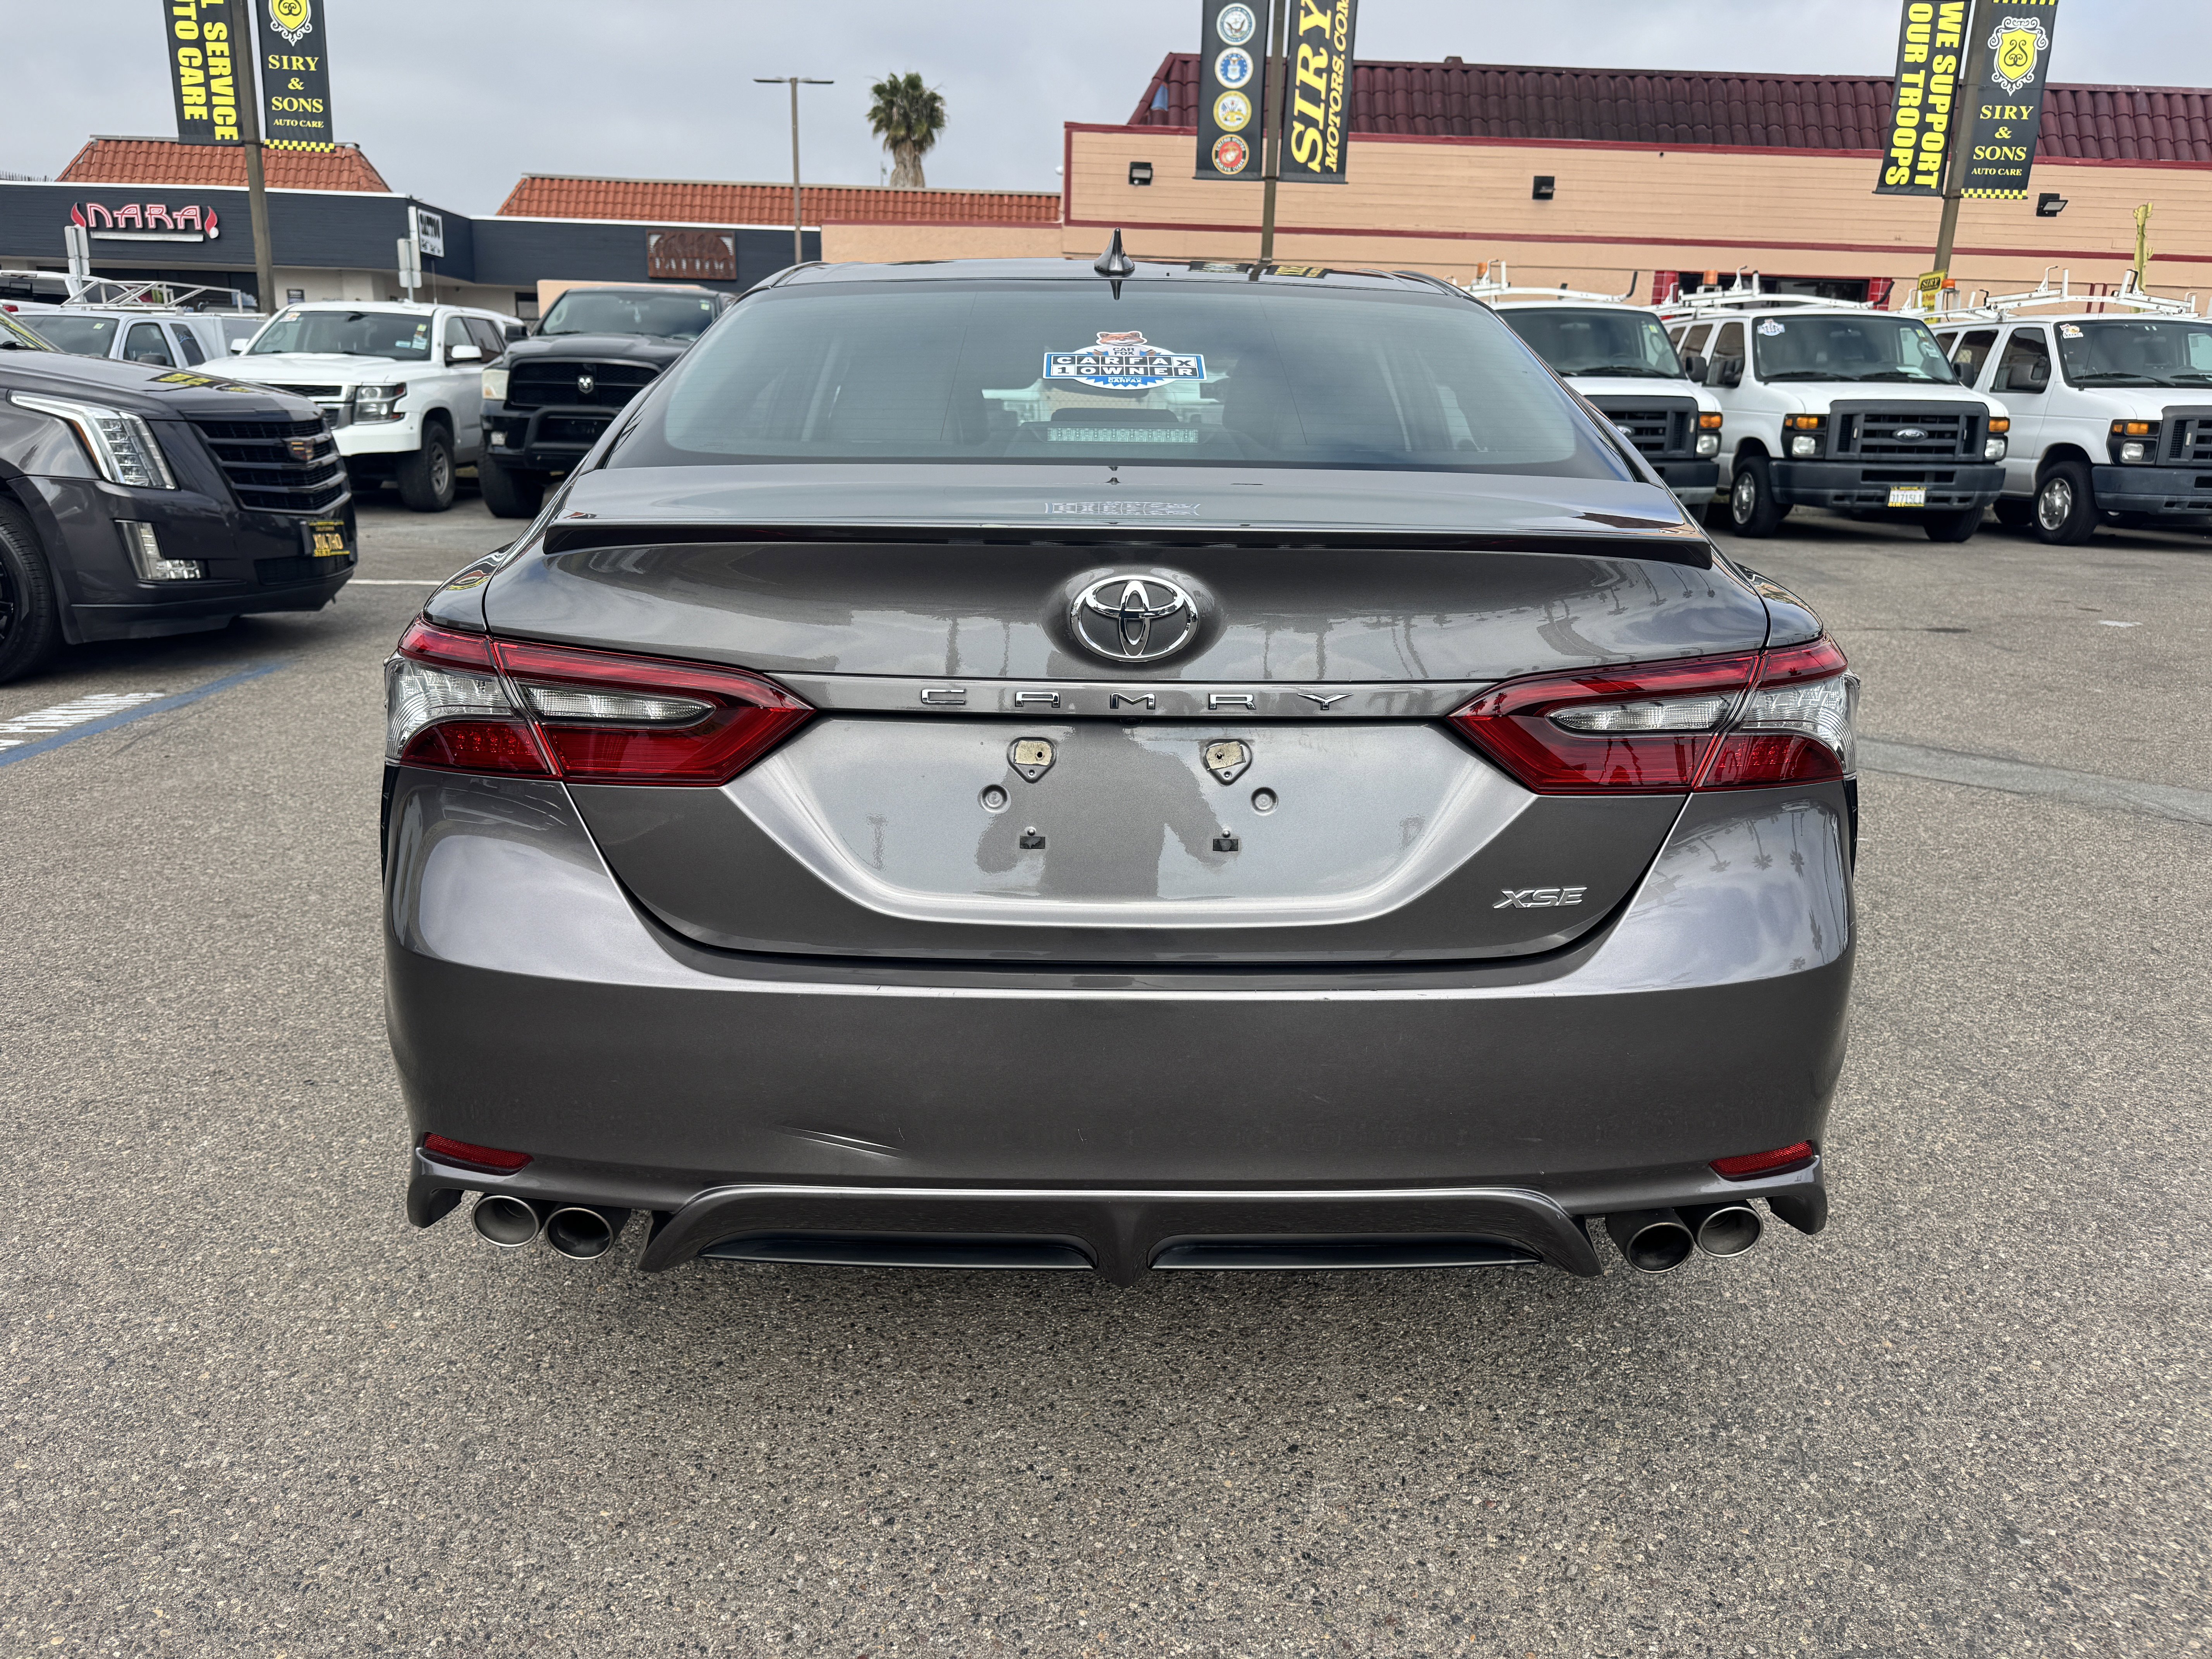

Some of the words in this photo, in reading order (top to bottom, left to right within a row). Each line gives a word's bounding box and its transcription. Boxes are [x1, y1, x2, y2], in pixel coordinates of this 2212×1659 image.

[173, 0, 199, 40] TO
[1936, 2, 1964, 48] WE
[1904, 3, 1933, 63] OUR
[268, 55, 319, 71] SIRY
[178, 47, 208, 120] CARE
[203, 22, 239, 140] SERVICE
[288, 77, 305, 90] &
[1291, 0, 1331, 173] SIRY
[1325, 0, 1349, 173] MOTORS.COM
[271, 96, 324, 113] SONS
[1980, 105, 2033, 120] SIRY
[299, 120, 324, 128] CARE
[1885, 70, 1925, 185] TROOPS
[1914, 55, 1957, 189] SUPPORT
[1995, 127, 2012, 139] &
[1973, 146, 2027, 161] SONS
[86, 202, 202, 230] NARA
[1056, 356, 1192, 366] CARFAX
[1080, 367, 1193, 376] OWNER
[921, 689, 1354, 710] CAMRY
[1493, 886, 1587, 908] XSE
